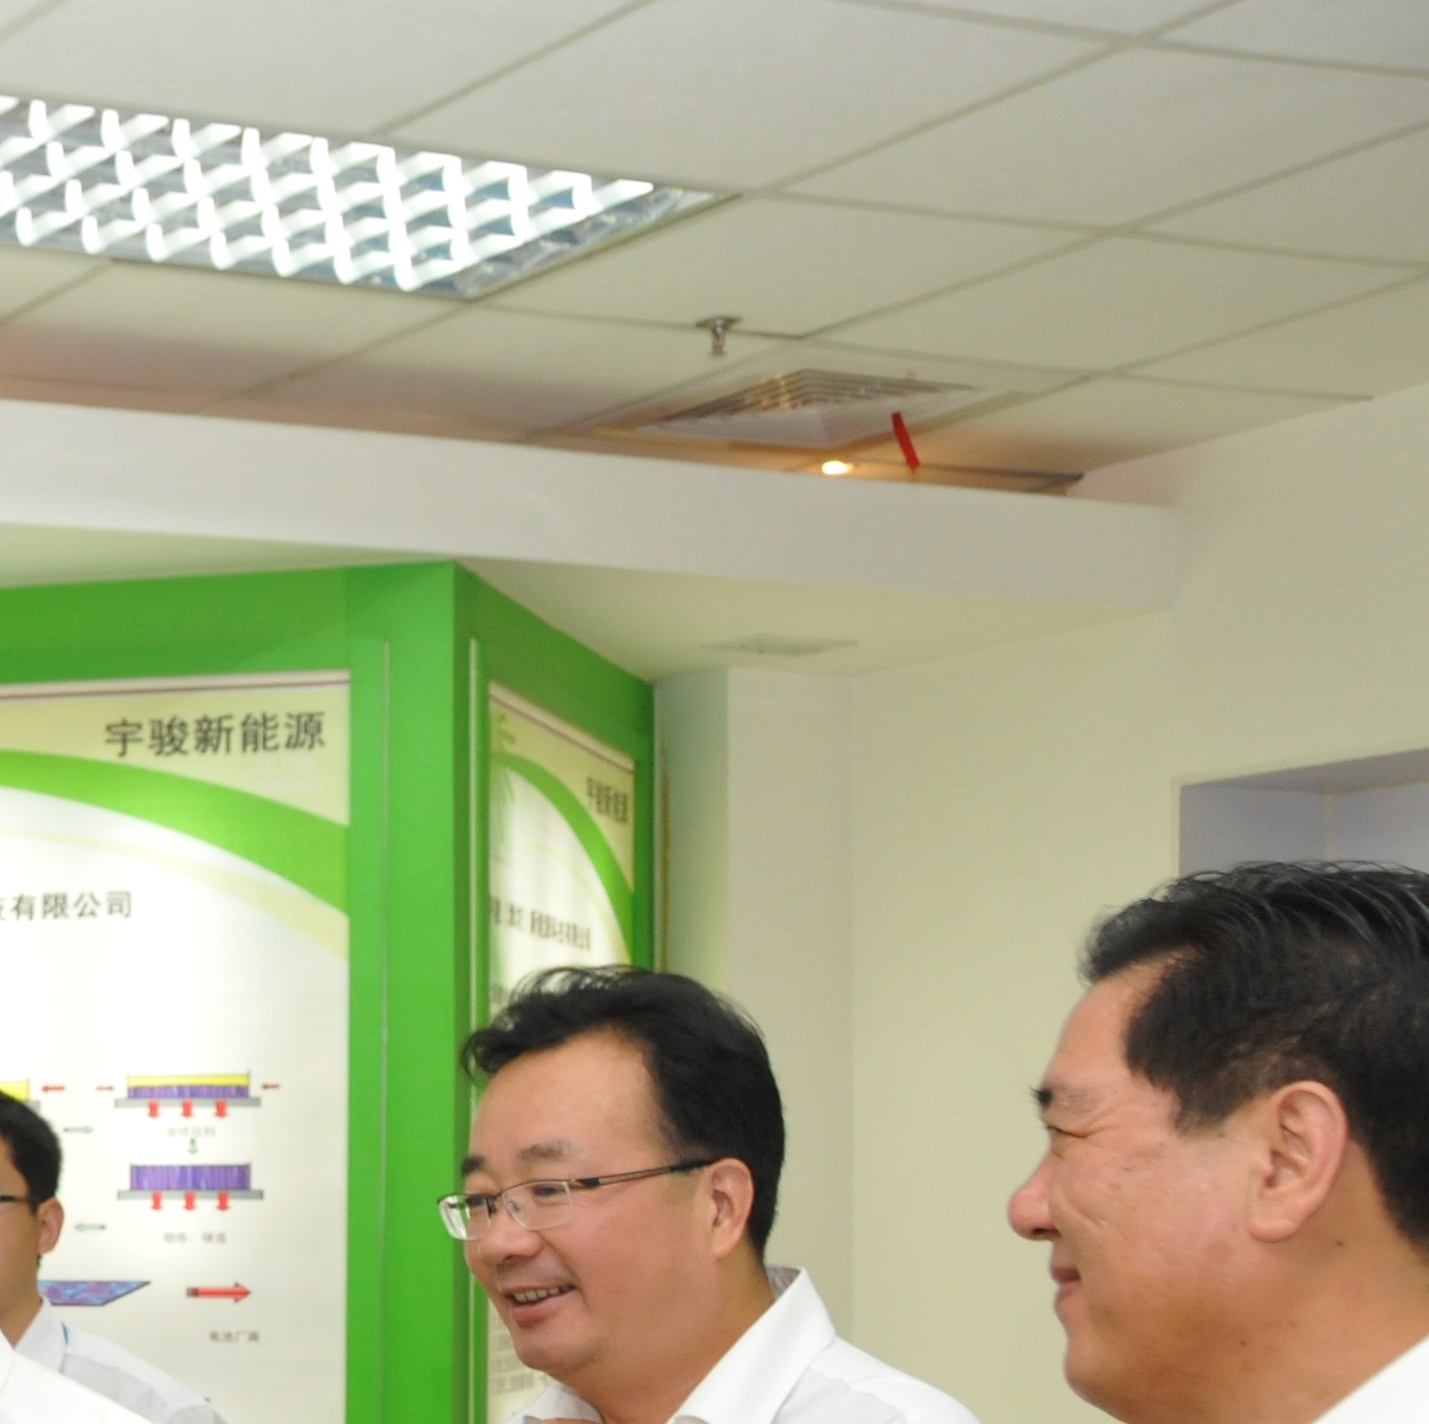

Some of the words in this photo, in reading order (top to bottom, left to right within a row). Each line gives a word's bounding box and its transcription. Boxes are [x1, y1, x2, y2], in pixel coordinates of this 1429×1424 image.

[104, 711, 326, 759] 宇骏新能源
